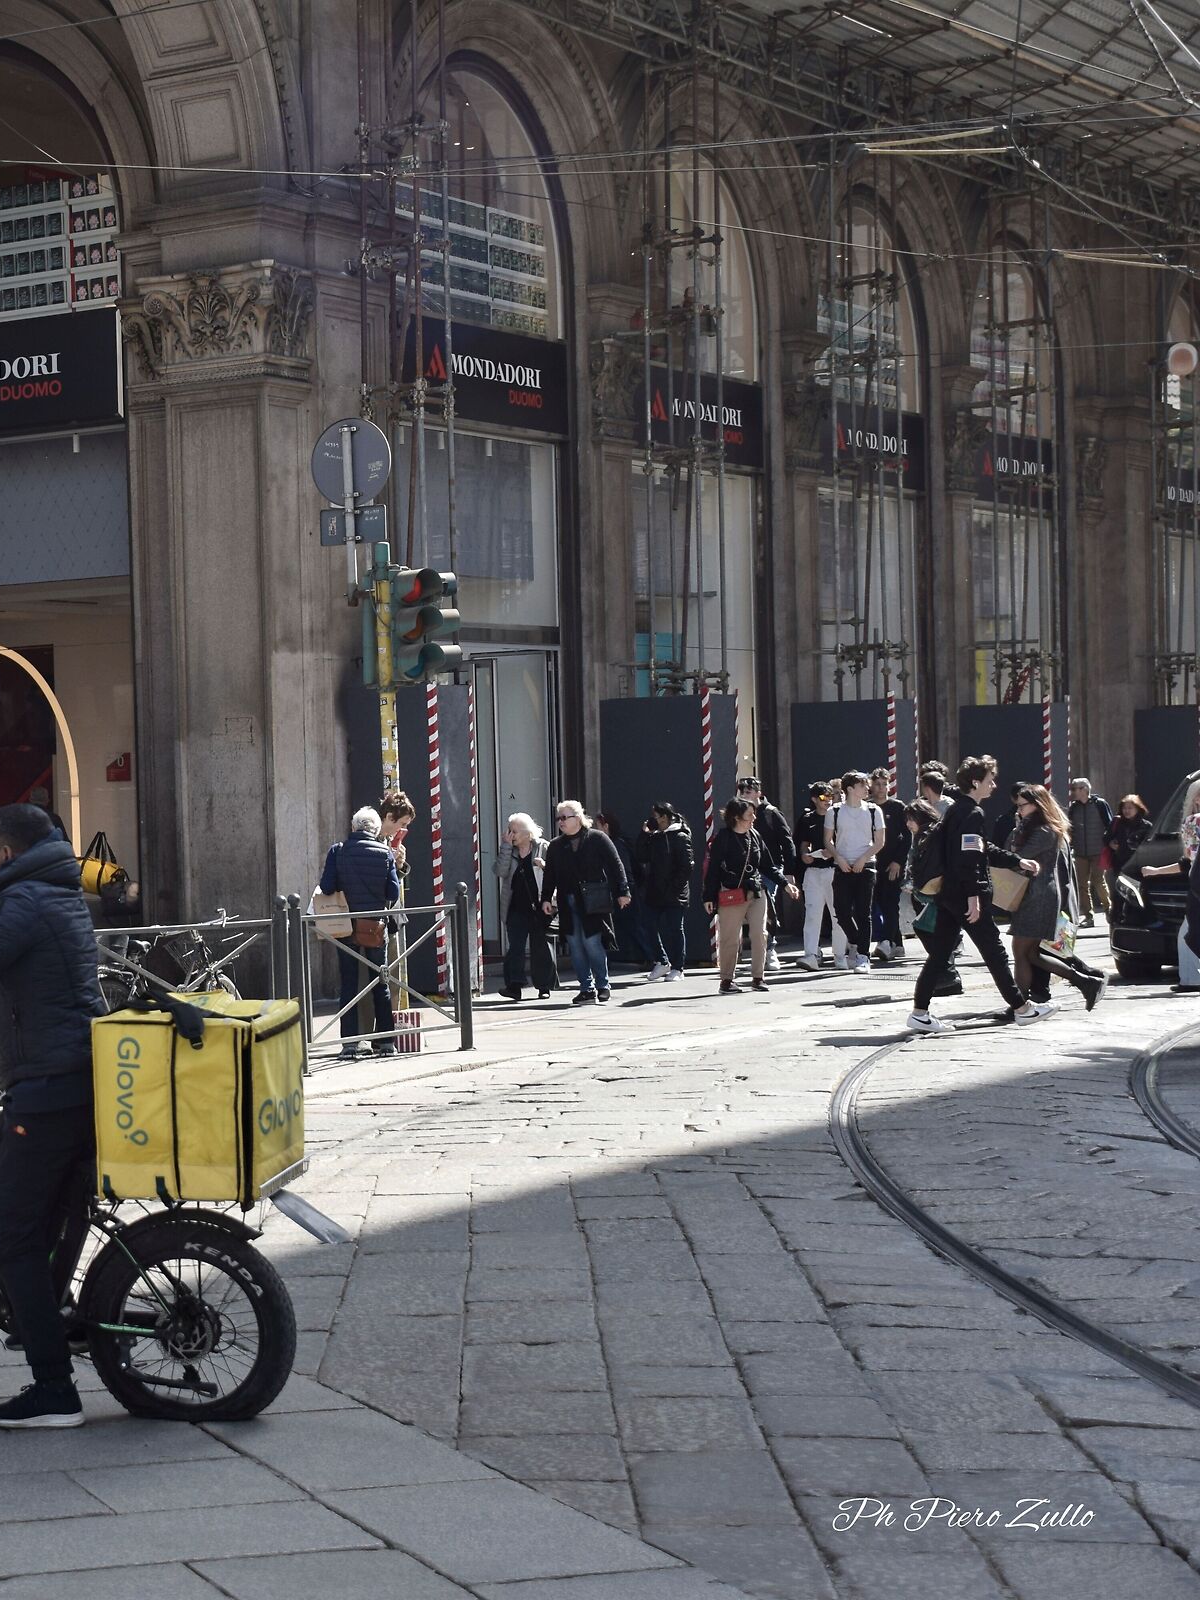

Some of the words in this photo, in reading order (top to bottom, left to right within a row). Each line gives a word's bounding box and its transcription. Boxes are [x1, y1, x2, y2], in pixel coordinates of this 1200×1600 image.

[450, 353, 542, 389] MONDADORI
[0, 380, 62, 401] DUOMO
[508, 388, 543, 409] DUOMO
[116, 1036, 141, 1130] Glovo
[184, 1241, 264, 1297] KENDA
